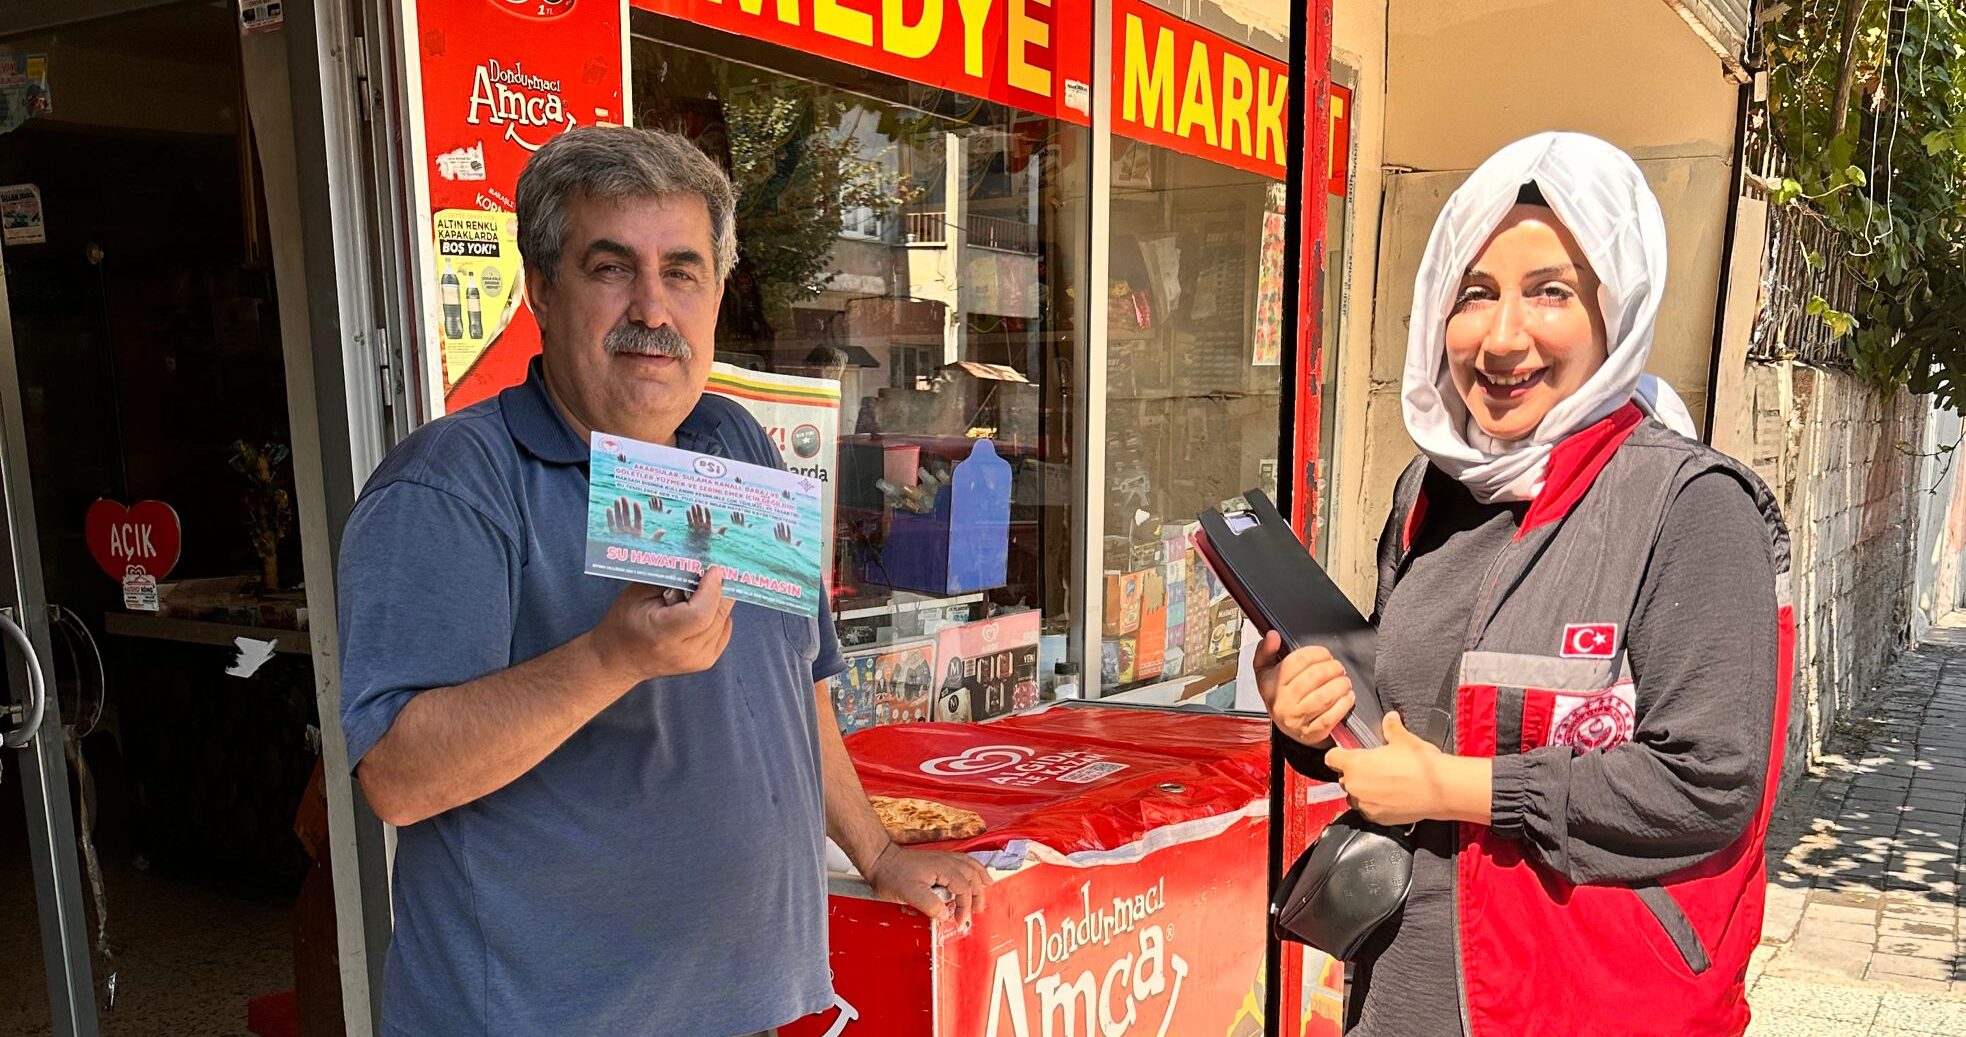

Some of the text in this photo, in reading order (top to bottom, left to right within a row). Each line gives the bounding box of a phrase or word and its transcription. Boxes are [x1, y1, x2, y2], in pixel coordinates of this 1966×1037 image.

[489, 59, 561, 92] Dondurmacı
[467, 65, 564, 126] Amca
[1122, 12, 1344, 180] MARKT
[437, 219, 498, 232] ALTIN RENKLİ
[438, 230, 499, 241] KAPAKLARDA
[442, 241, 465, 256] BOŞ
[784, 462, 828, 482] arda
[111, 523, 157, 562] AÇIK
[607, 546, 628, 561] SU
[630, 549, 705, 577] HAYATTIR,
[707, 563, 738, 581] AN
[740, 571, 801, 598] ALMASIN
[987, 751, 1087, 785] ALGIDA
[1024, 876, 1166, 984] Dondurmacı
[984, 924, 1167, 1037] Amca
